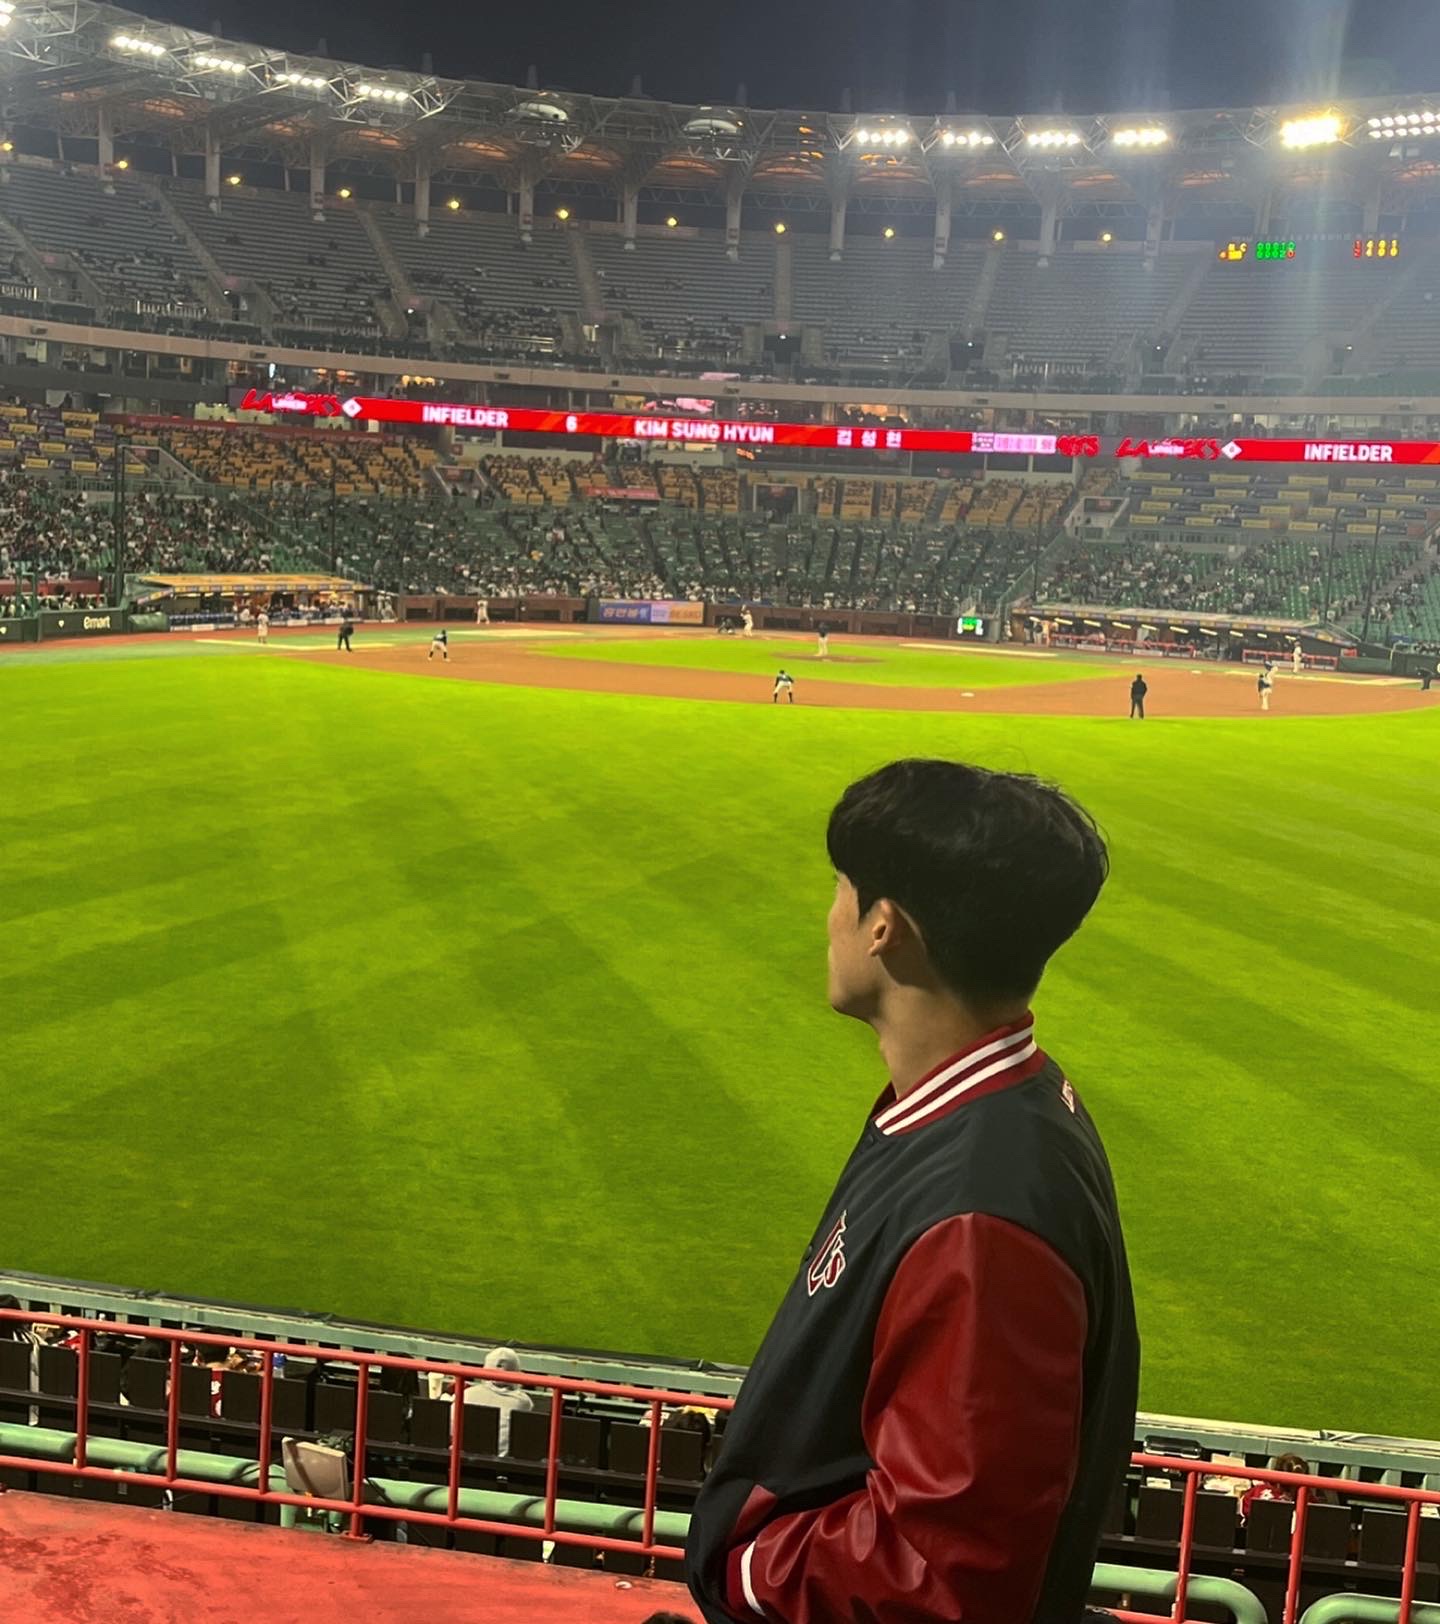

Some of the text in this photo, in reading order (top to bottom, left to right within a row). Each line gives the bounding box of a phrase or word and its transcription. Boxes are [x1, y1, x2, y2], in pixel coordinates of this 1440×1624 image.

[422, 405, 774, 442] INFIELDER 6 KIM SUNG HYUN
[1304, 443, 1393, 462] INFIELDER
